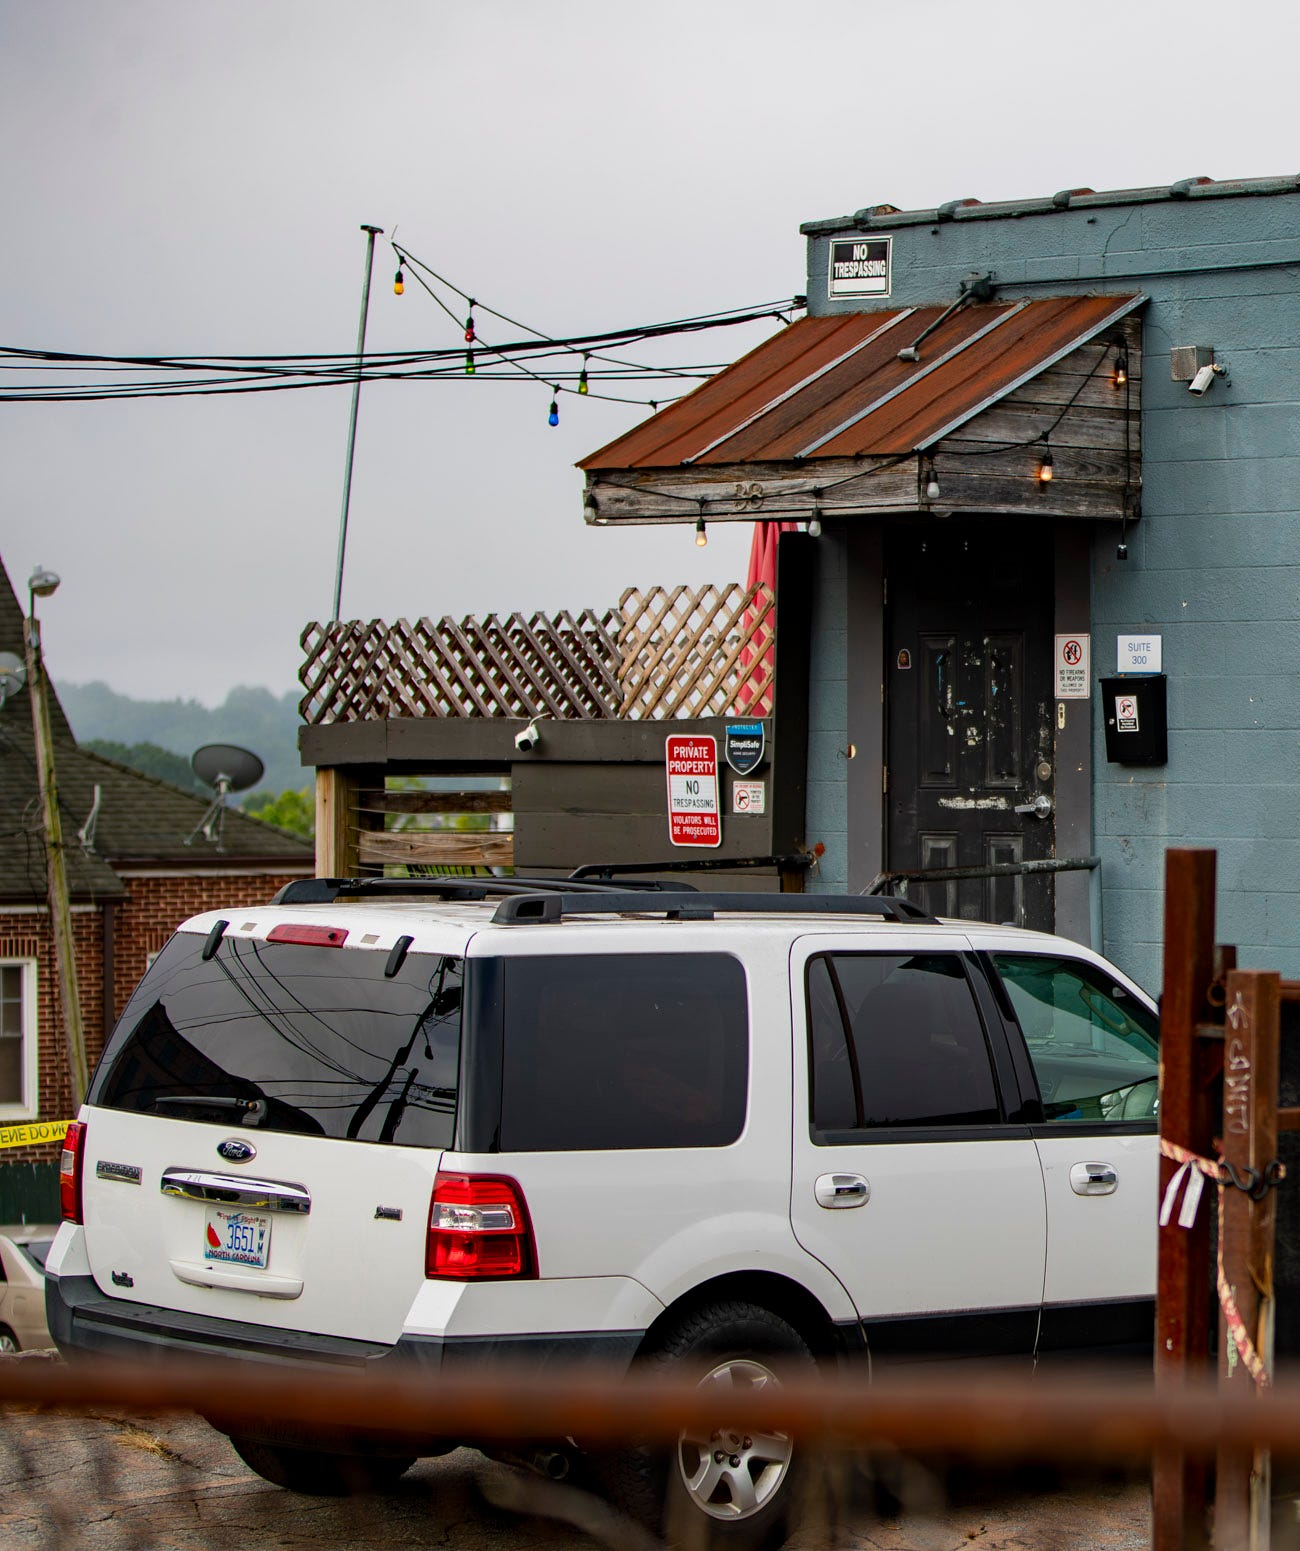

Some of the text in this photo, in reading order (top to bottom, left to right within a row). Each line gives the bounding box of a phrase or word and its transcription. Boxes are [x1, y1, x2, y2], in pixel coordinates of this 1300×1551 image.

[853, 244, 868, 260] NO
[834, 260, 886, 278] TRESPASSING
[734, 483, 764, 511] 38
[1128, 642, 1151, 652] SUITE
[1132, 655, 1147, 665] 300
[730, 740, 760, 750] SimpliSafe
[674, 746, 709, 759] PRIVATE
[669, 760, 714, 773] PROPERTY
[686, 780, 699, 795] NO
[673, 798, 714, 809] TRESPASSING
[673, 816, 716, 825] VIOLATORS WILL
[673, 826, 717, 836] BE PROSECUTED
[222, 1141, 245, 1158] Ford
[227, 1224, 254, 1252] 3651
[209, 1249, 261, 1263] NORTH CAROLINA
